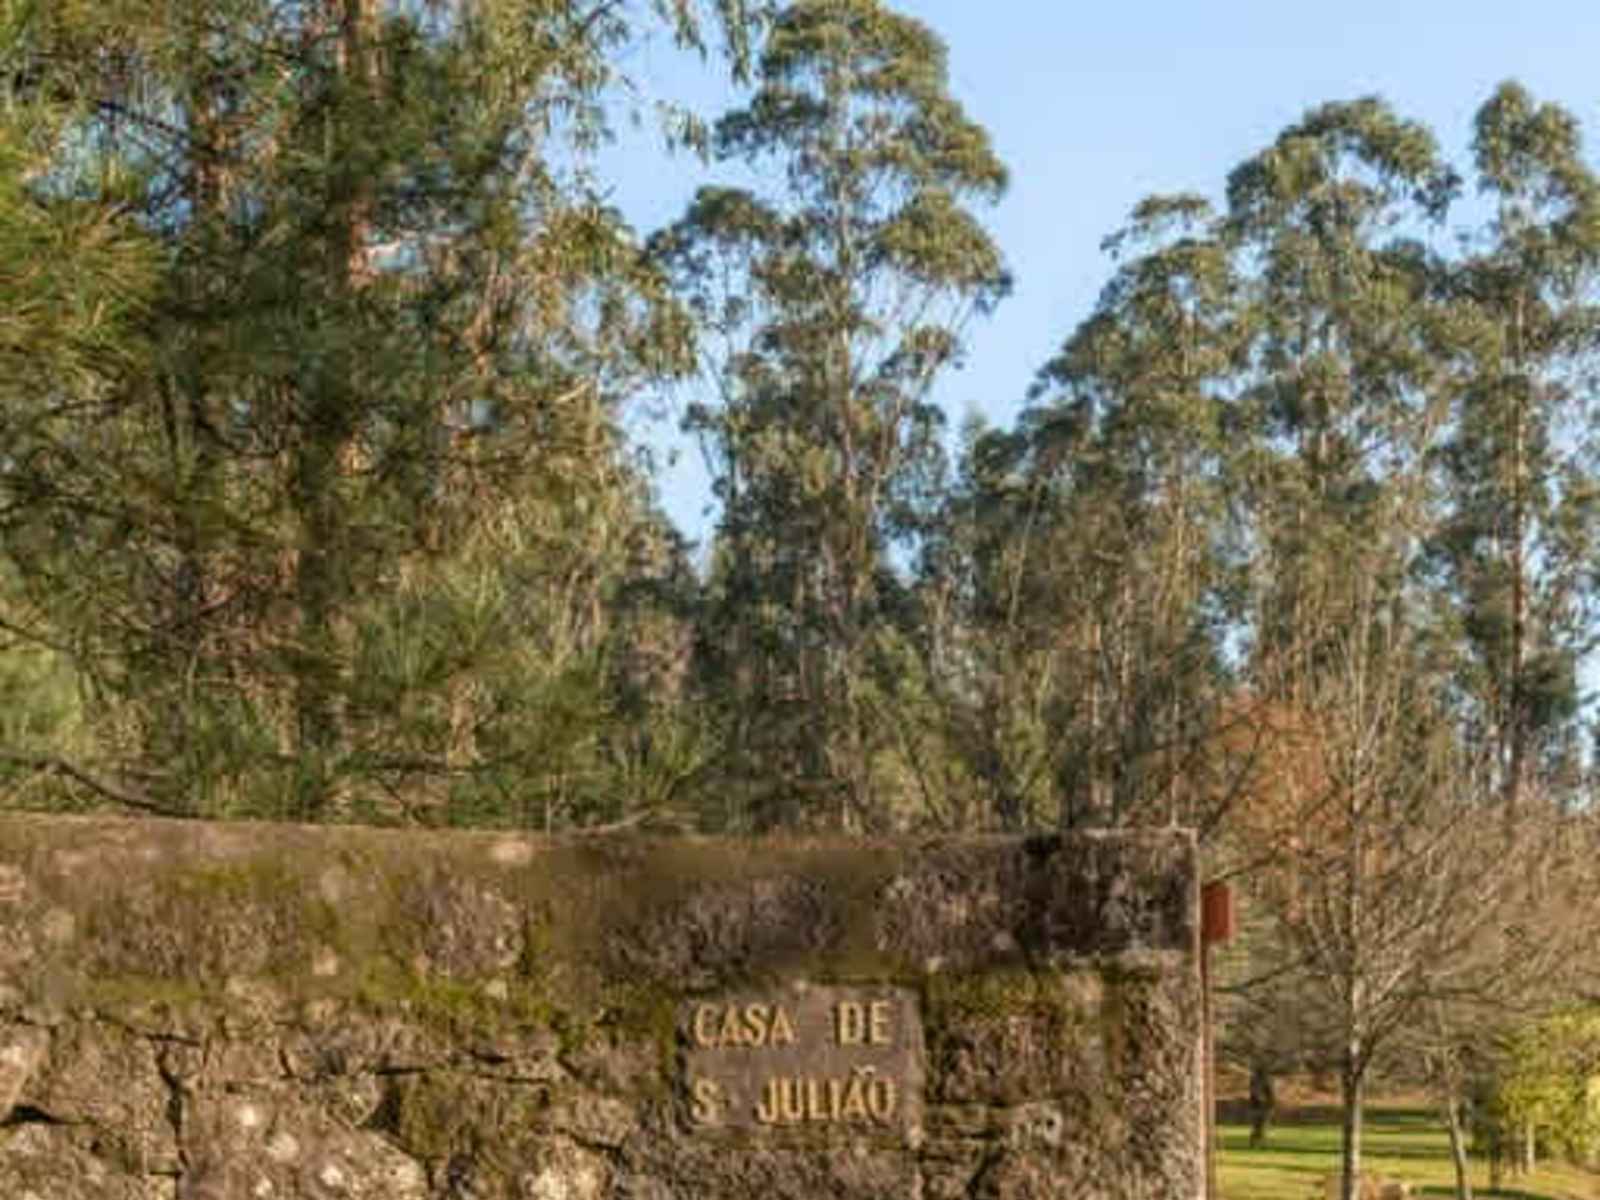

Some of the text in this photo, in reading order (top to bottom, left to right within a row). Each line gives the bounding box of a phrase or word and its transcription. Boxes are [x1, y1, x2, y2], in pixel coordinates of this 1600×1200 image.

[695, 1001, 893, 1048] CASA DE
[757, 1064, 897, 1123] JULIÃO
